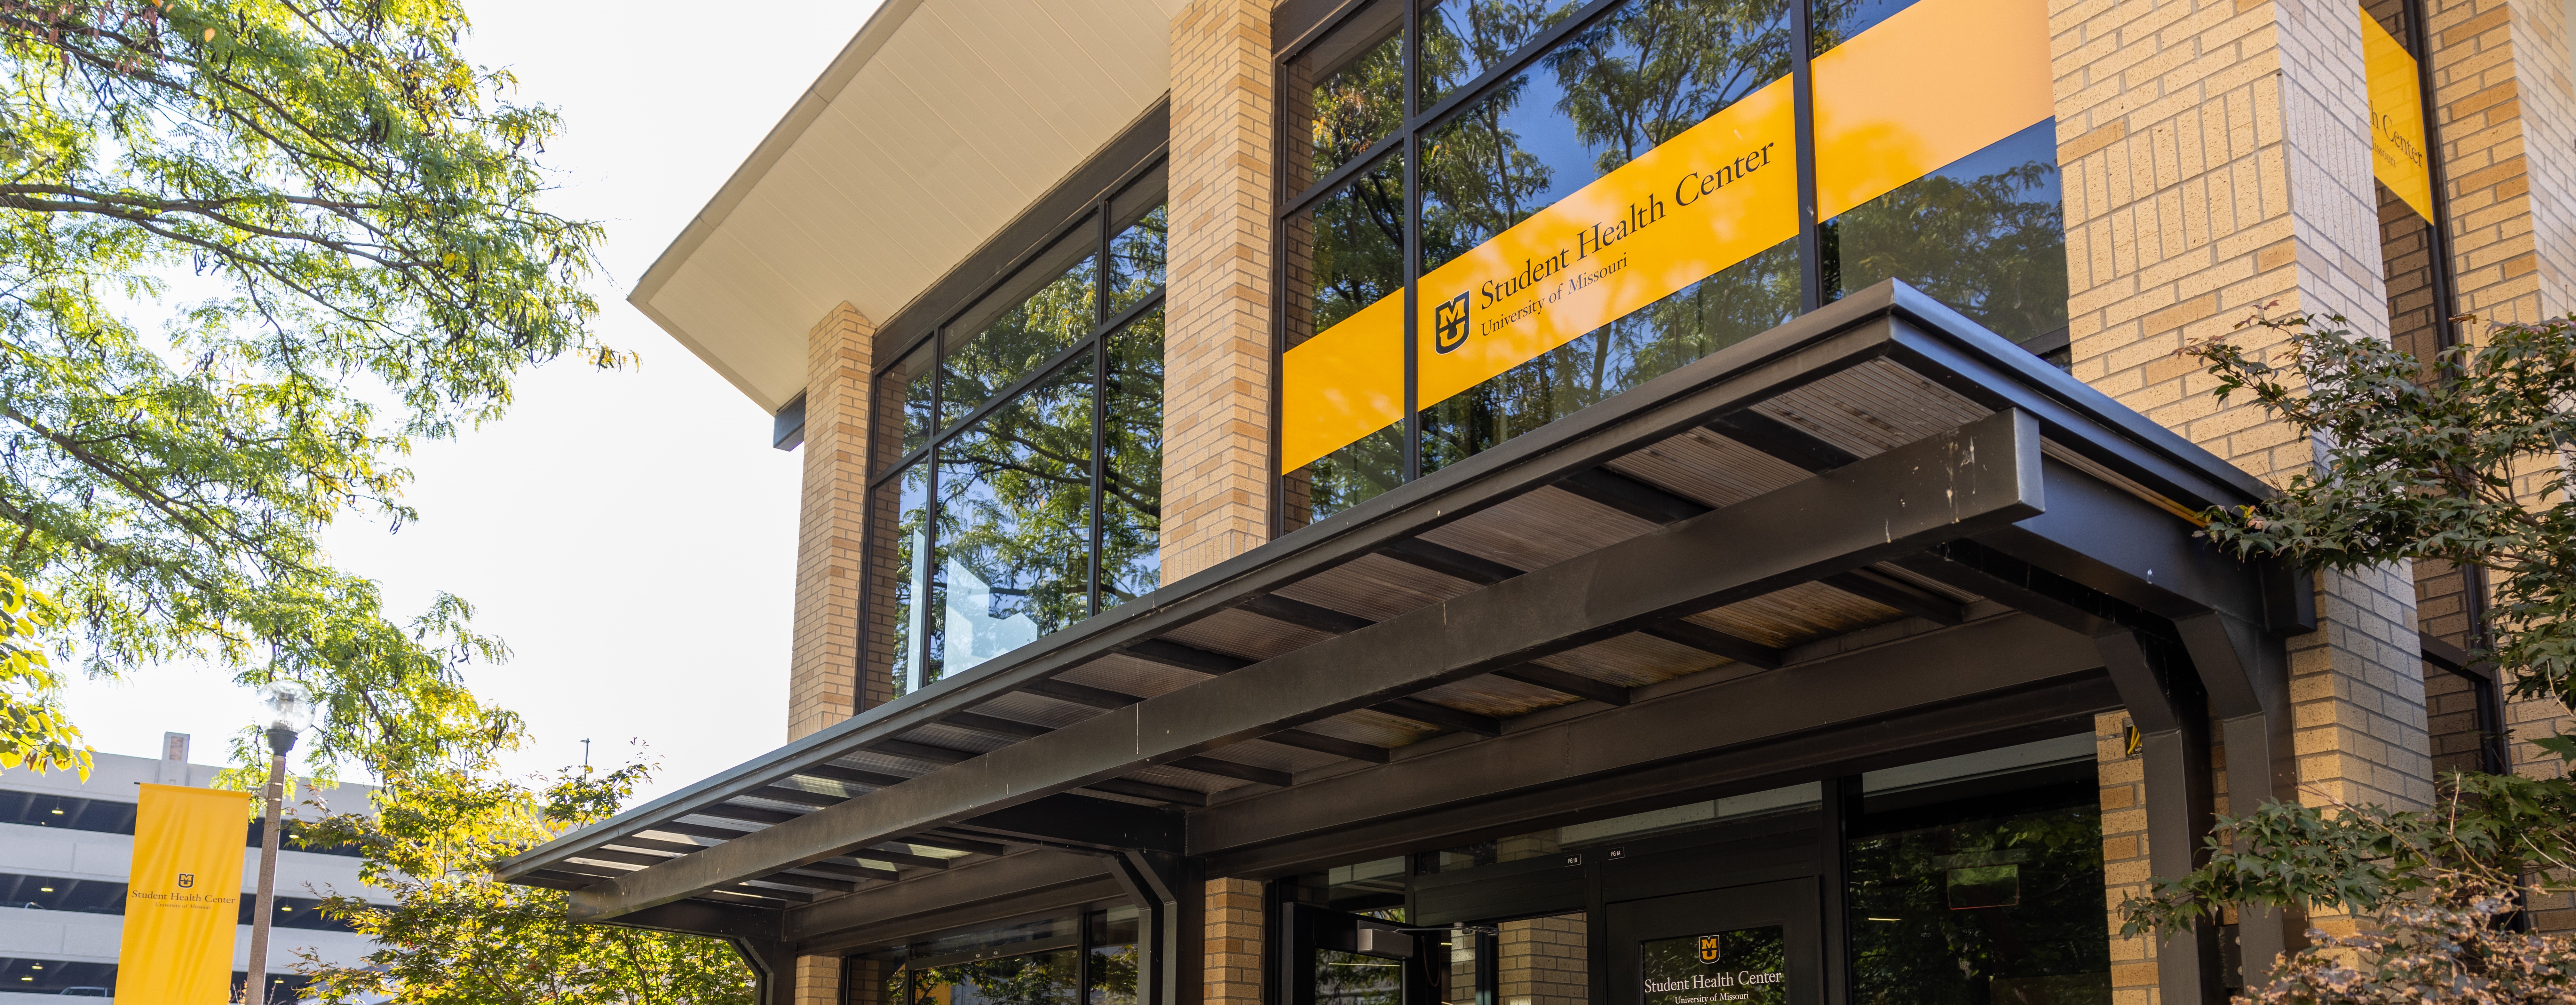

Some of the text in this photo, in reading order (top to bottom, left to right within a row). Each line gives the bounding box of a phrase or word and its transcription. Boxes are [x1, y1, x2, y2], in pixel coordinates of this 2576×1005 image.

[2383, 115, 2422, 168] Center
[1482, 142, 1774, 310] Student Health Center
[1481, 252, 1627, 336] University of Missouri
[132, 890, 235, 904] Student Health Center
[1645, 971, 1782, 993] Student Health Center
[1675, 992, 1749, 1004] University of Missouri
